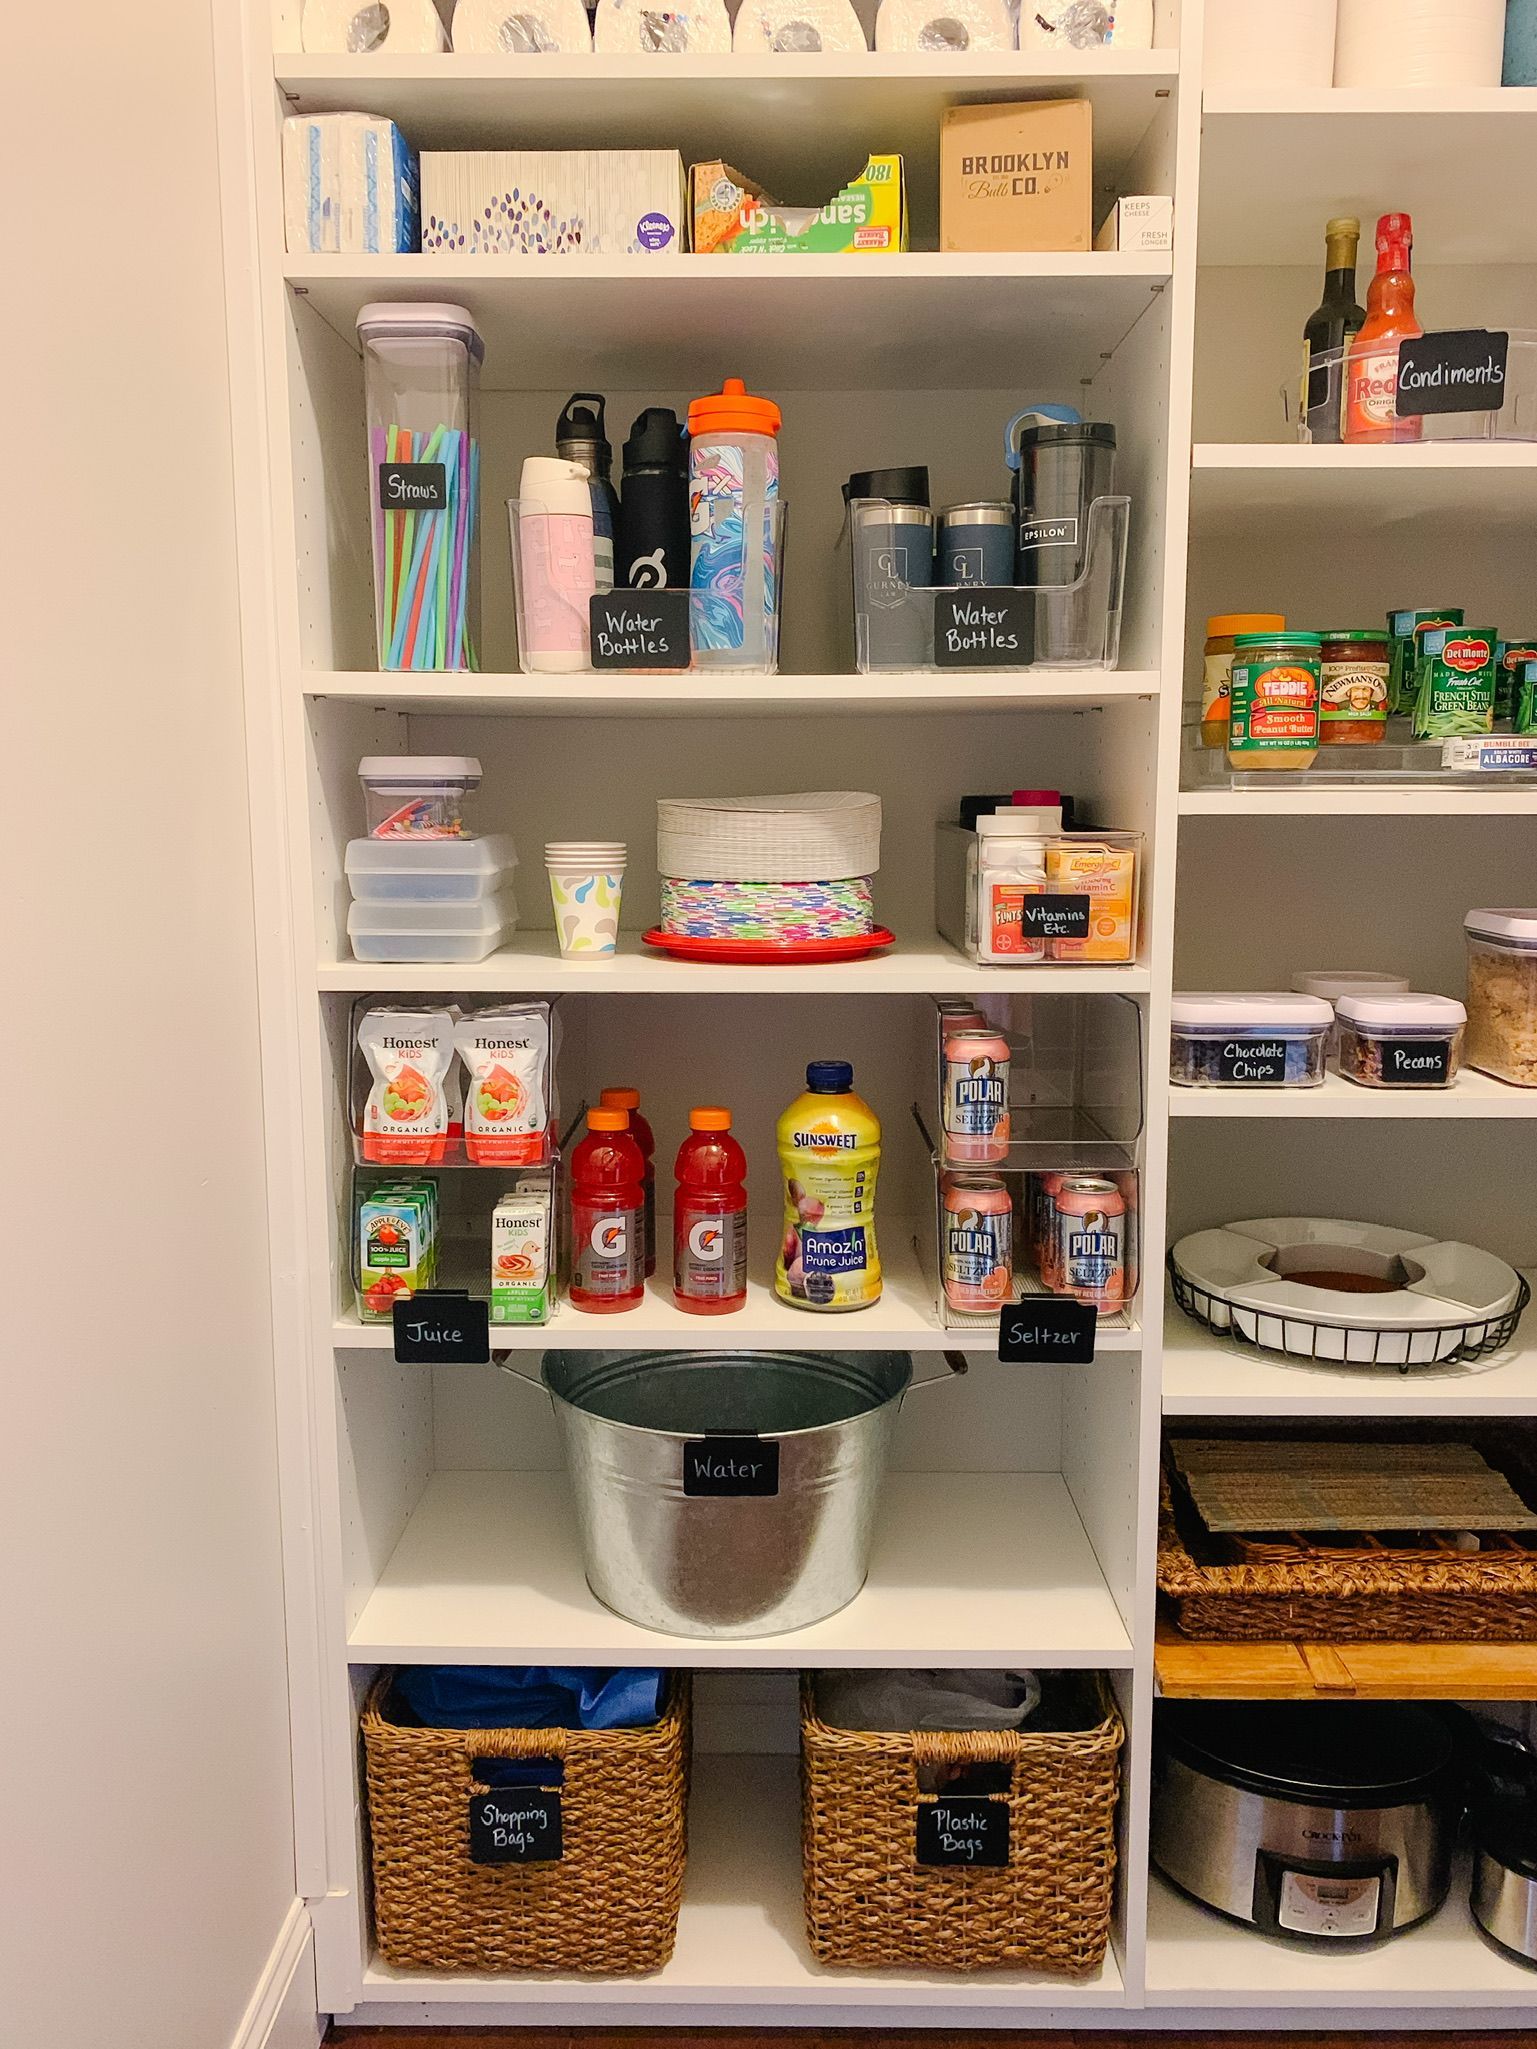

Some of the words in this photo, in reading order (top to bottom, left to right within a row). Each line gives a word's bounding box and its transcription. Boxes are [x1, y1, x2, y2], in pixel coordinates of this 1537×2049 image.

[962, 151, 1069, 175] BROOKLYN
[866, 165, 892, 181] 180
[967, 180, 1010, 199] Bulb
[1012, 177, 1040, 196] CO.
[1124, 203, 1150, 211] KEEPS
[1141, 231, 1168, 239] FRESH
[1399, 356, 1504, 390] Condiments
[388, 474, 438, 500] Straws
[1024, 526, 1066, 541] EPSILON
[605, 610, 662, 632] Water
[952, 602, 1008, 625] Water
[597, 633, 669, 656] Bottles
[946, 628, 1018, 651] Bottles
[1446, 649, 1461, 658] Del
[1462, 648, 1488, 658] Monte
[1263, 681, 1308, 696] TEDDIE
[1433, 690, 1469, 701] FRENCH
[1274, 697, 1307, 707] Natural
[1434, 700, 1465, 711] GREEN
[1266, 713, 1306, 725] Smooth
[1254, 724, 1288, 734] Peanut
[1289, 724, 1314, 734] Butter
[1483, 754, 1530, 764] ALBACORE
[1026, 906, 1086, 921] Vitamins
[1043, 923, 1070, 935] Etc.
[382, 1037, 439, 1049] Honest
[475, 1038, 530, 1049] Honest
[1224, 1042, 1284, 1059] Chocolate
[1394, 1050, 1443, 1070] Pecans
[1232, 1062, 1274, 1080] Chips
[959, 1080, 1003, 1103] POLAR
[955, 1114, 1004, 1124] SELTZER
[478, 1125, 524, 1133] ORGANIC
[794, 1132, 857, 1149] SUNSWEET
[370, 1217, 389, 1231] APPLE
[396, 1219, 409, 1234] EVE
[496, 1217, 542, 1228] Honest
[590, 1216, 627, 1258] G
[688, 1219, 724, 1261] G
[951, 1231, 993, 1256] POLAR
[1072, 1235, 1116, 1257] POLAR
[806, 1255, 837, 1267] Prune
[838, 1255, 864, 1267] Juice
[949, 1264, 995, 1276] SELTZER
[1069, 1266, 1118, 1277] SELTZER
[406, 1322, 463, 1343] Juice
[1008, 1322, 1080, 1345] Seltzer
[694, 1455, 763, 1478] Water
[480, 1802, 548, 1830] Shopping
[930, 1809, 988, 1833] Plastic
[491, 1828, 536, 1854] Bags
[939, 1834, 984, 1860] Bags
